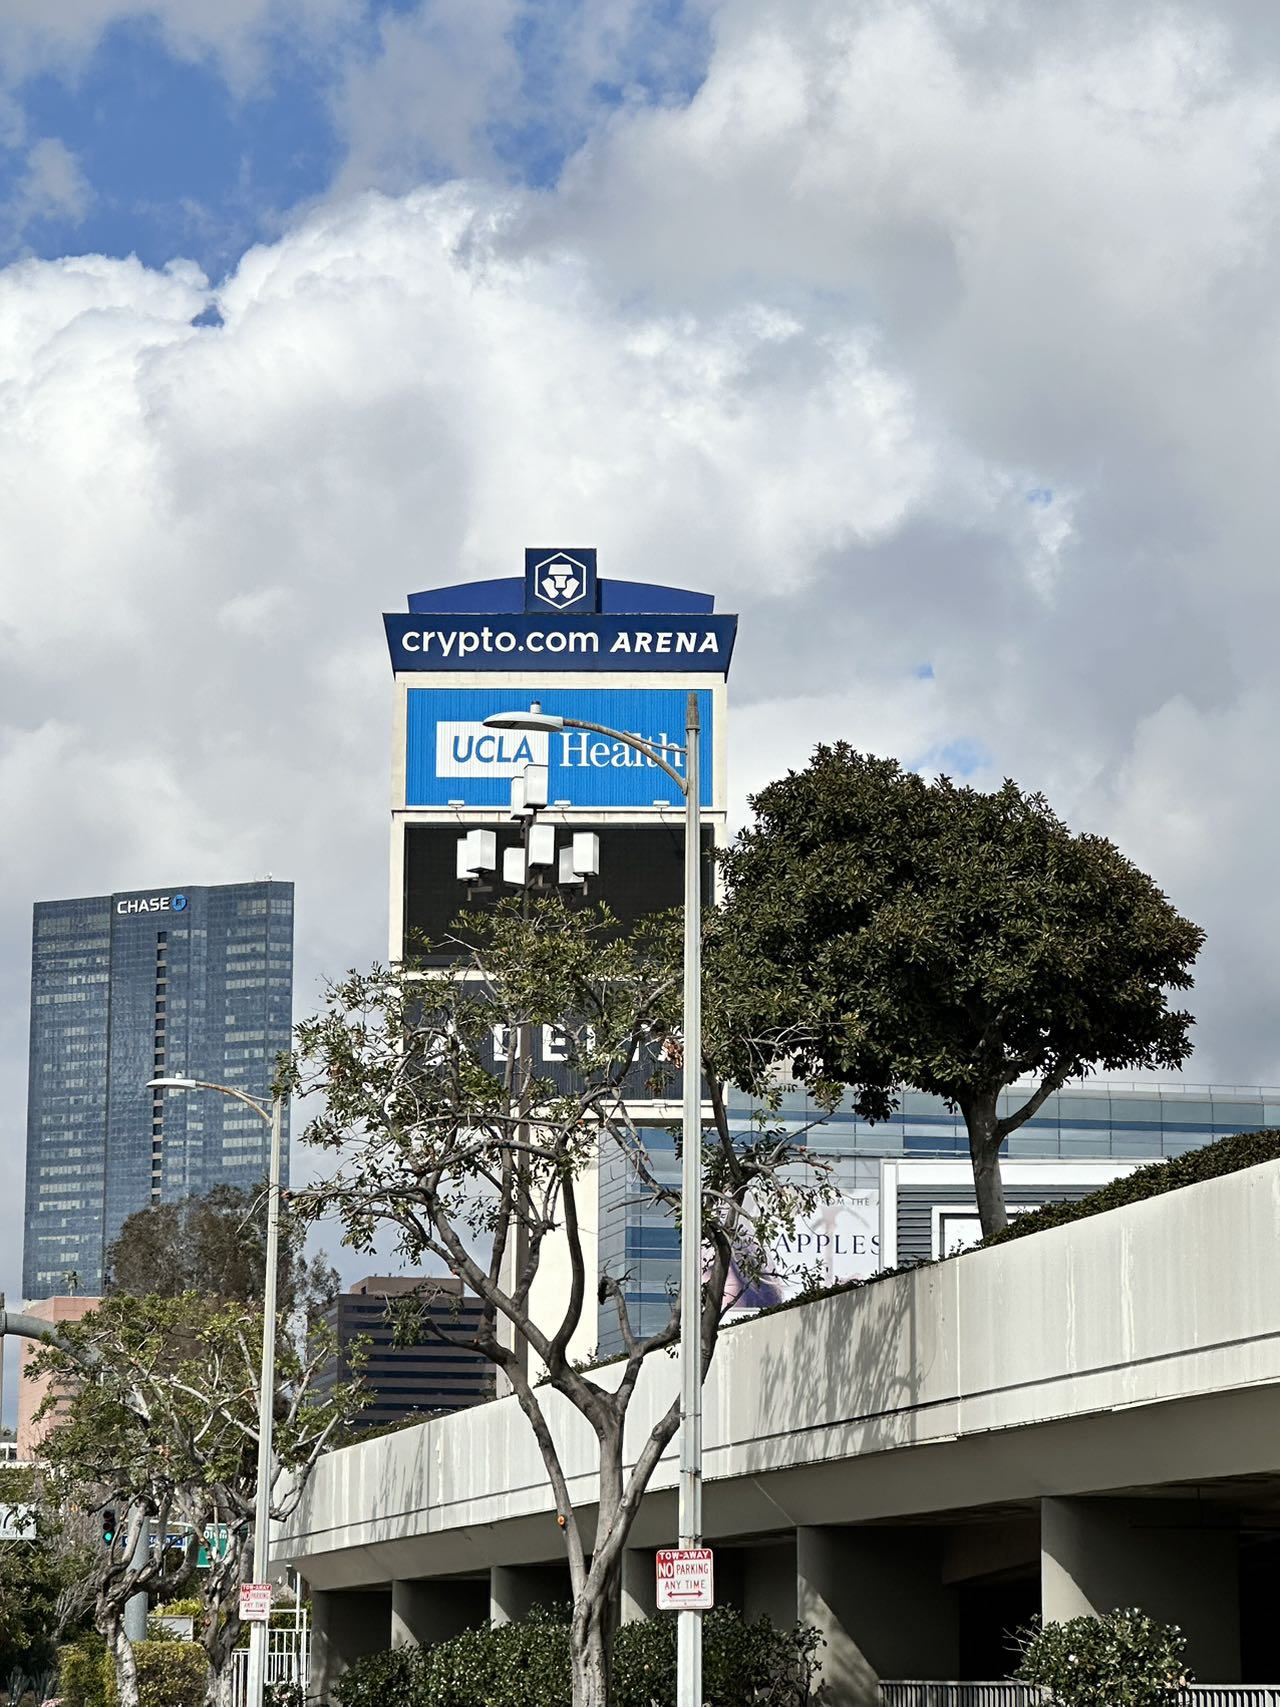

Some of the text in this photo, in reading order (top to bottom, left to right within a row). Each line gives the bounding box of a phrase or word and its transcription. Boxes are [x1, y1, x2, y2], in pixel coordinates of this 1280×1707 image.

[402, 627, 719, 656] crypto.com ARENA
[452, 735, 534, 763] UCLA
[117, 897, 170, 914] CHASE
[850, 1198, 870, 1206] THE
[774, 1234, 879, 1254] APPLES
[659, 1551, 709, 1560] TOW-AWAY
[658, 1562, 708, 1577] NO PARKING
[665, 1580, 706, 1590] ANY TIME
